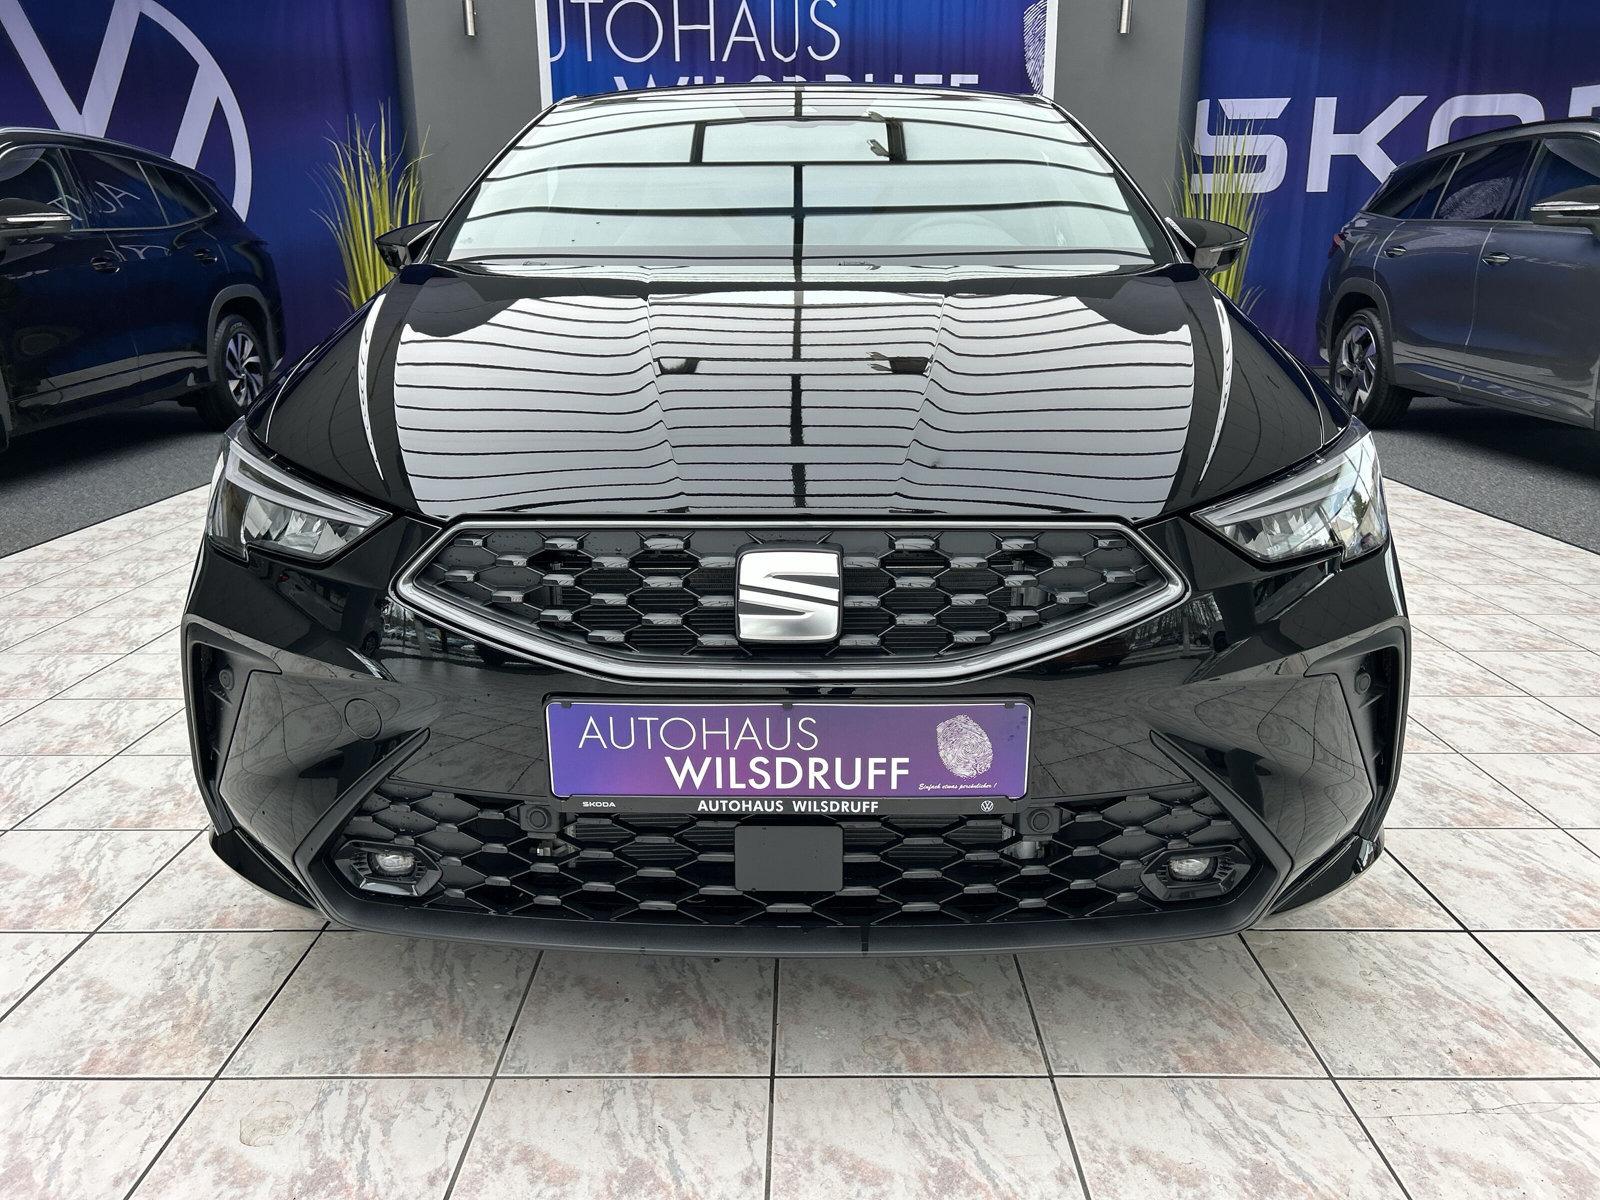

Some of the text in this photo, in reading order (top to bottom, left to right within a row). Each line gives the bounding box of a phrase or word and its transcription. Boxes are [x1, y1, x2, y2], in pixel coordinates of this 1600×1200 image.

[578, 716, 819, 751] AUTOHAUS
[664, 756, 910, 791] WILSDRUFF
[697, 799, 879, 813] AUTOHAUS WILSDRUFF
